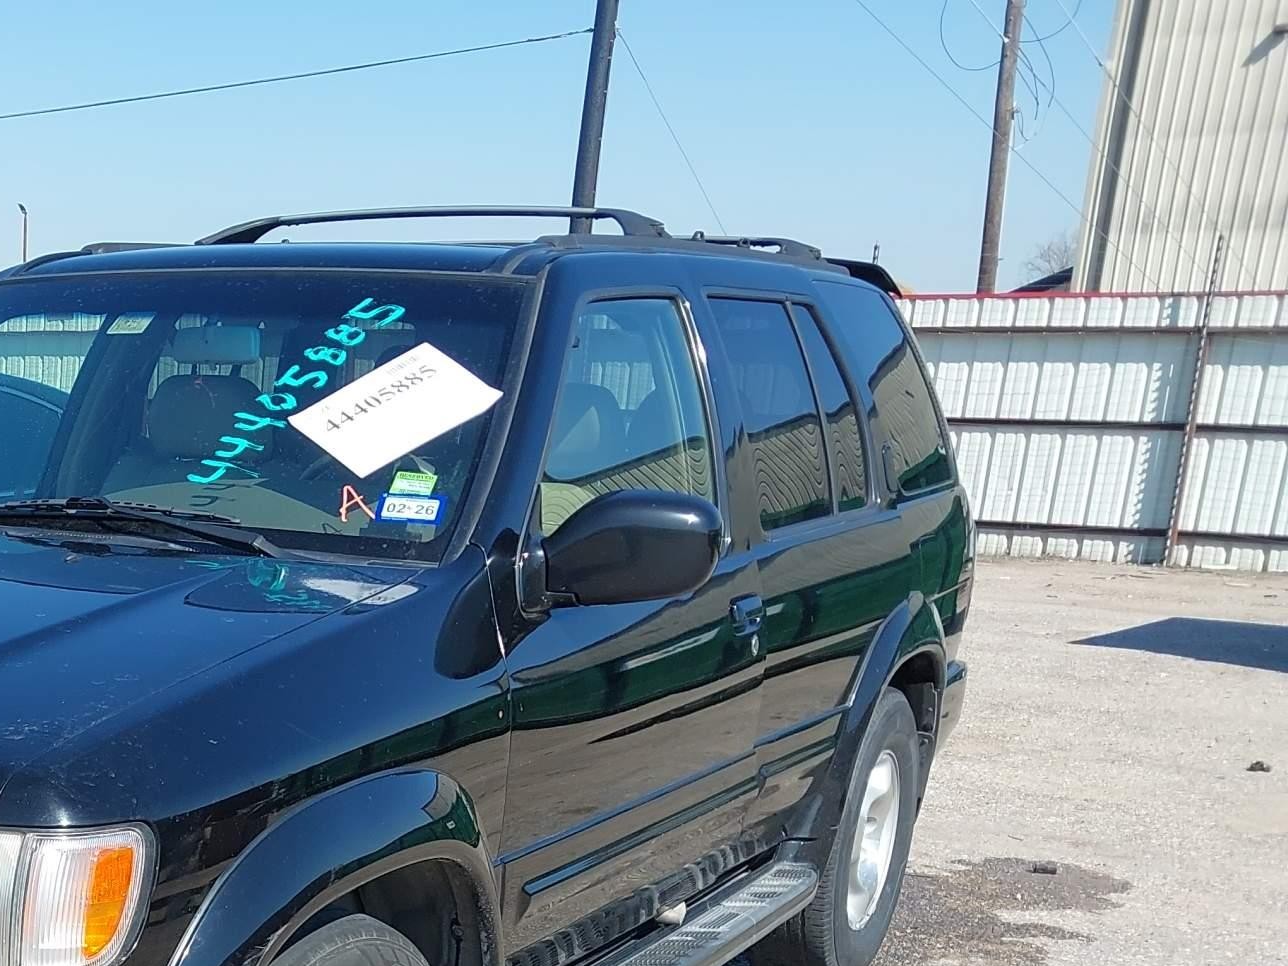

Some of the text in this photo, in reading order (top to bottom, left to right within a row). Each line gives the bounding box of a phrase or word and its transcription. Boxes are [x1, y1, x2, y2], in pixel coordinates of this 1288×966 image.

[187, 298, 406, 484] 44405885
[326, 365, 438, 432] 44405885
[339, 485, 376, 522] A
